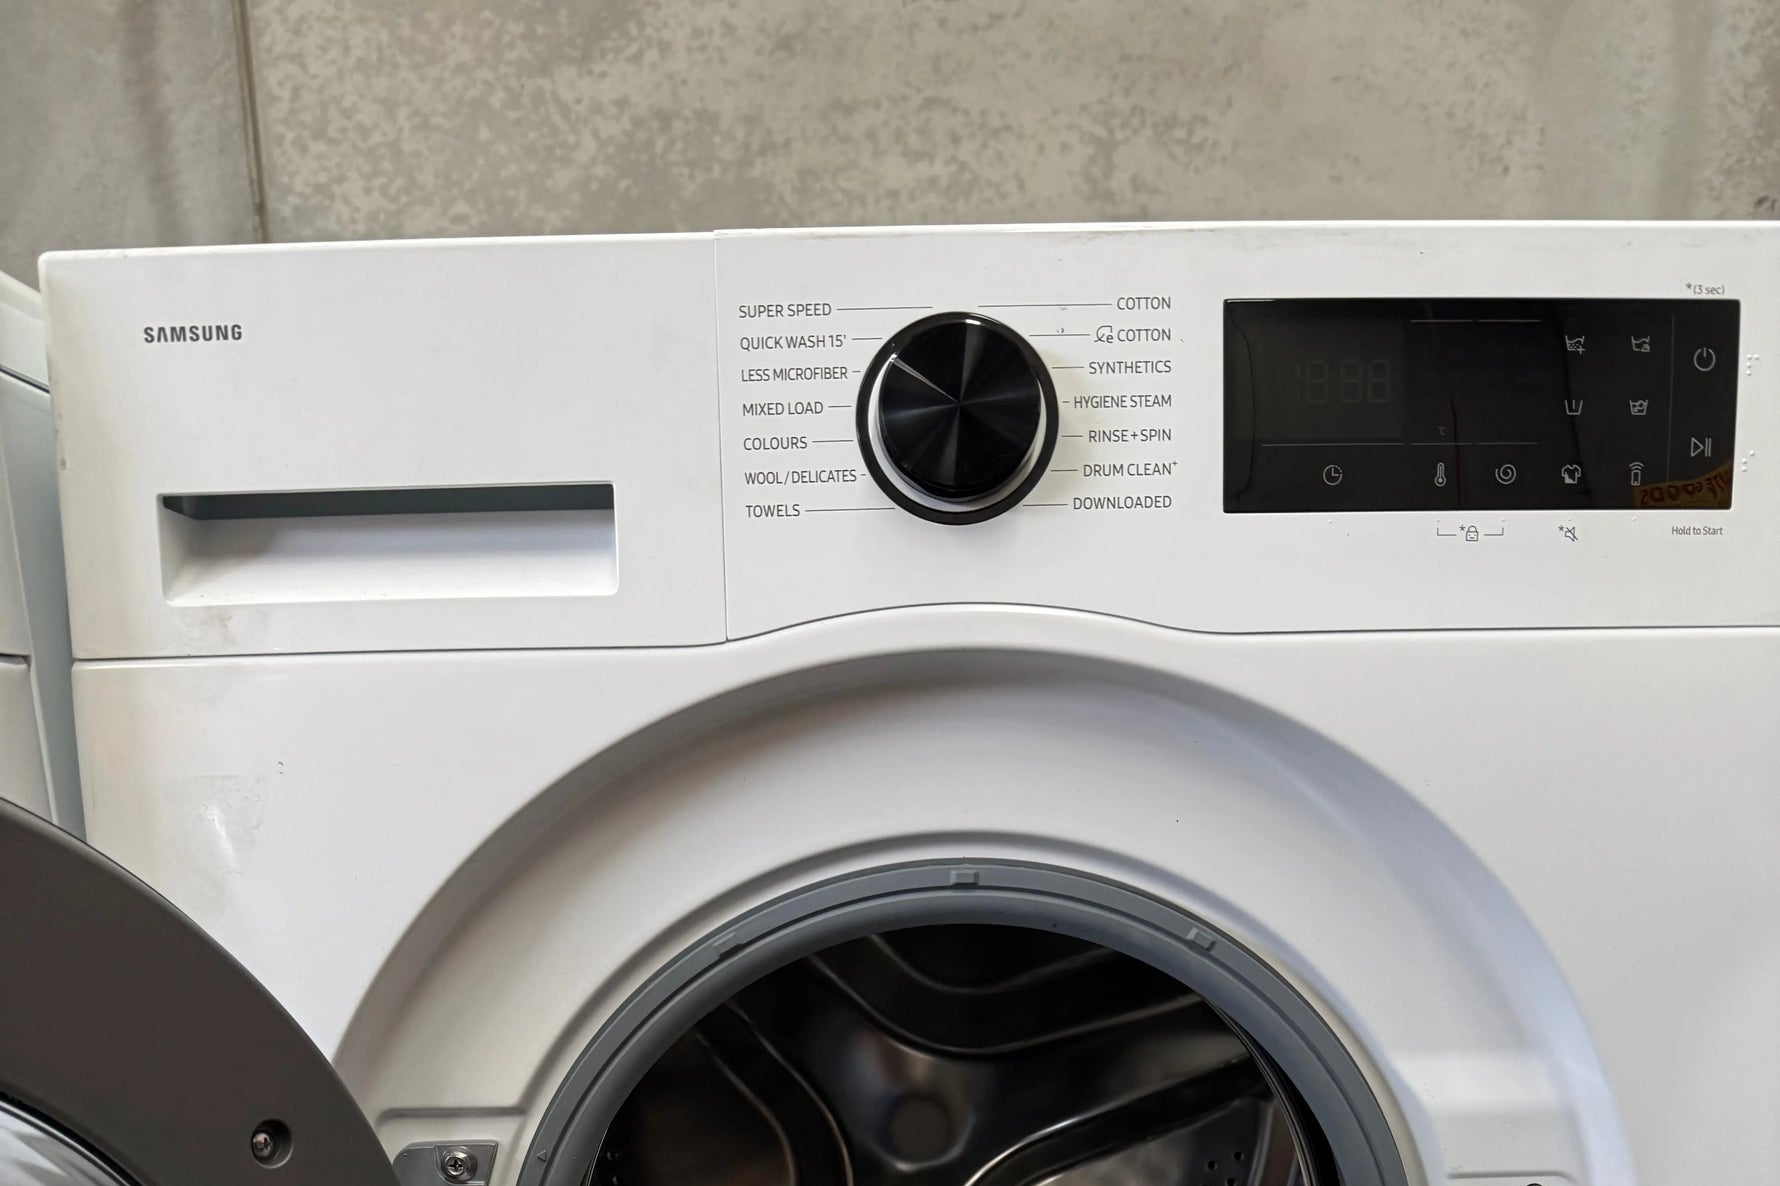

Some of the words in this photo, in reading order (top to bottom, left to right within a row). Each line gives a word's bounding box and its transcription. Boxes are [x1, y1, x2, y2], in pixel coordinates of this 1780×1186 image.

[1705, 285, 1725, 295] sec)
[1117, 296, 1171, 310] COTTON
[739, 305, 784, 319] SUPER
[787, 303, 832, 317] SPEED
[143, 324, 242, 344] SAMSUNG
[1117, 328, 1171, 341] COTTON
[740, 336, 783, 351] QUICK
[785, 335, 824, 349] WASH
[741, 369, 770, 382] LESS
[772, 366, 848, 381] MICROFIBER
[1089, 360, 1172, 374] SYNTHETICS
[742, 402, 784, 416] MIXED
[787, 401, 823, 415] LOAD
[1073, 395, 1127, 409] HYGIENE
[1129, 394, 1172, 408] STEAM
[743, 436, 808, 451] COLOURS
[1083, 463, 1124, 478] DRUM
[1073, 495, 1172, 510] DOWNLOADED
[745, 504, 800, 518] TOWELS
[1672, 526, 1690, 535] Hold
[1692, 527, 1701, 535] to
[1703, 526, 1723, 535] Start
